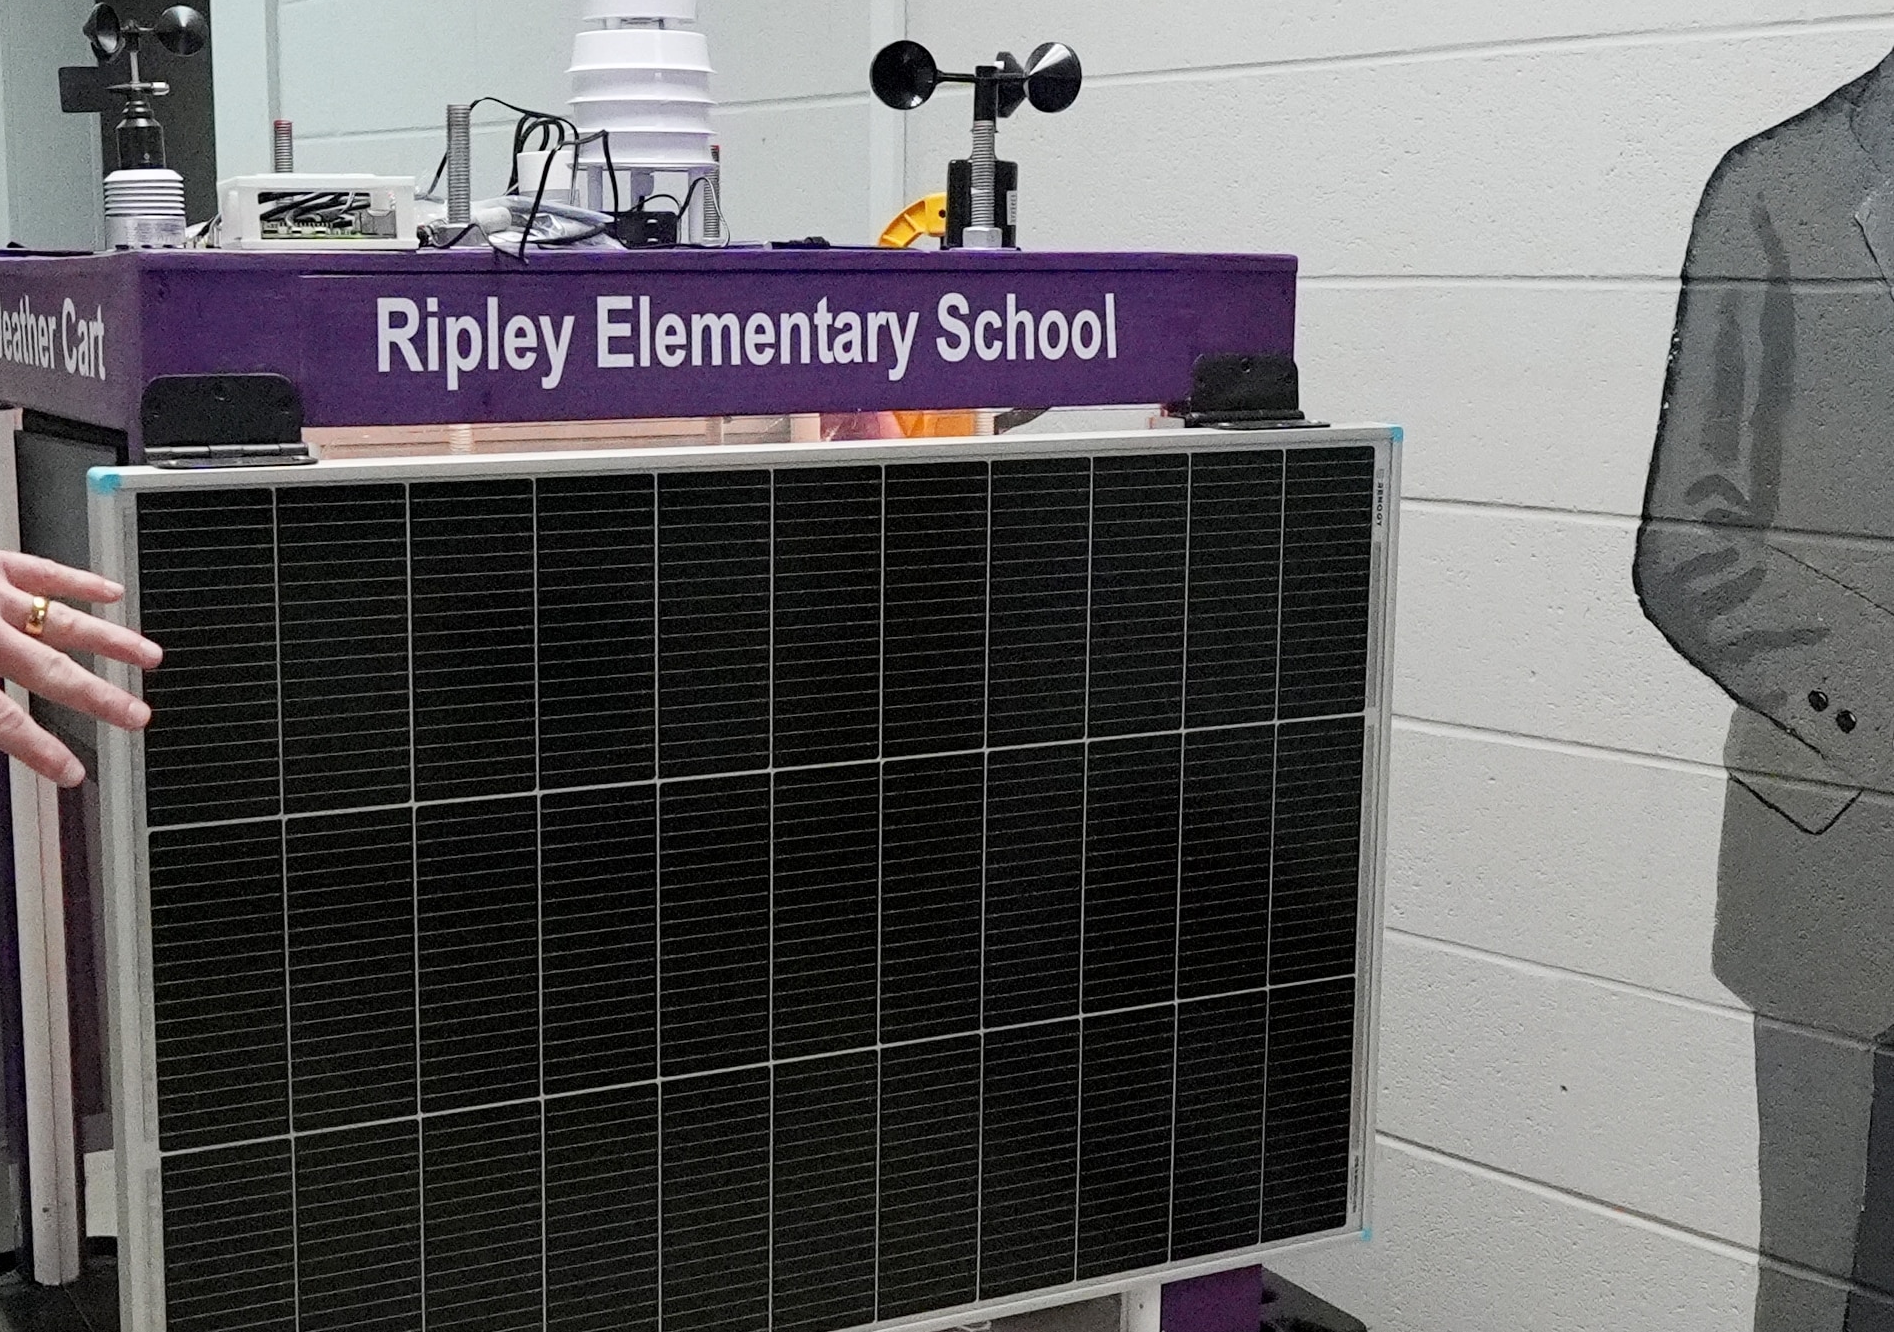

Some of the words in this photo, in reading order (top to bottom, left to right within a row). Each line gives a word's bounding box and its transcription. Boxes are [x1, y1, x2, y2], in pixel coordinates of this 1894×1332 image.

[60, 297, 106, 381] Cart
[376, 296, 575, 391] Ripley
[595, 295, 919, 381] Elementary
[936, 292, 1119, 363] School
